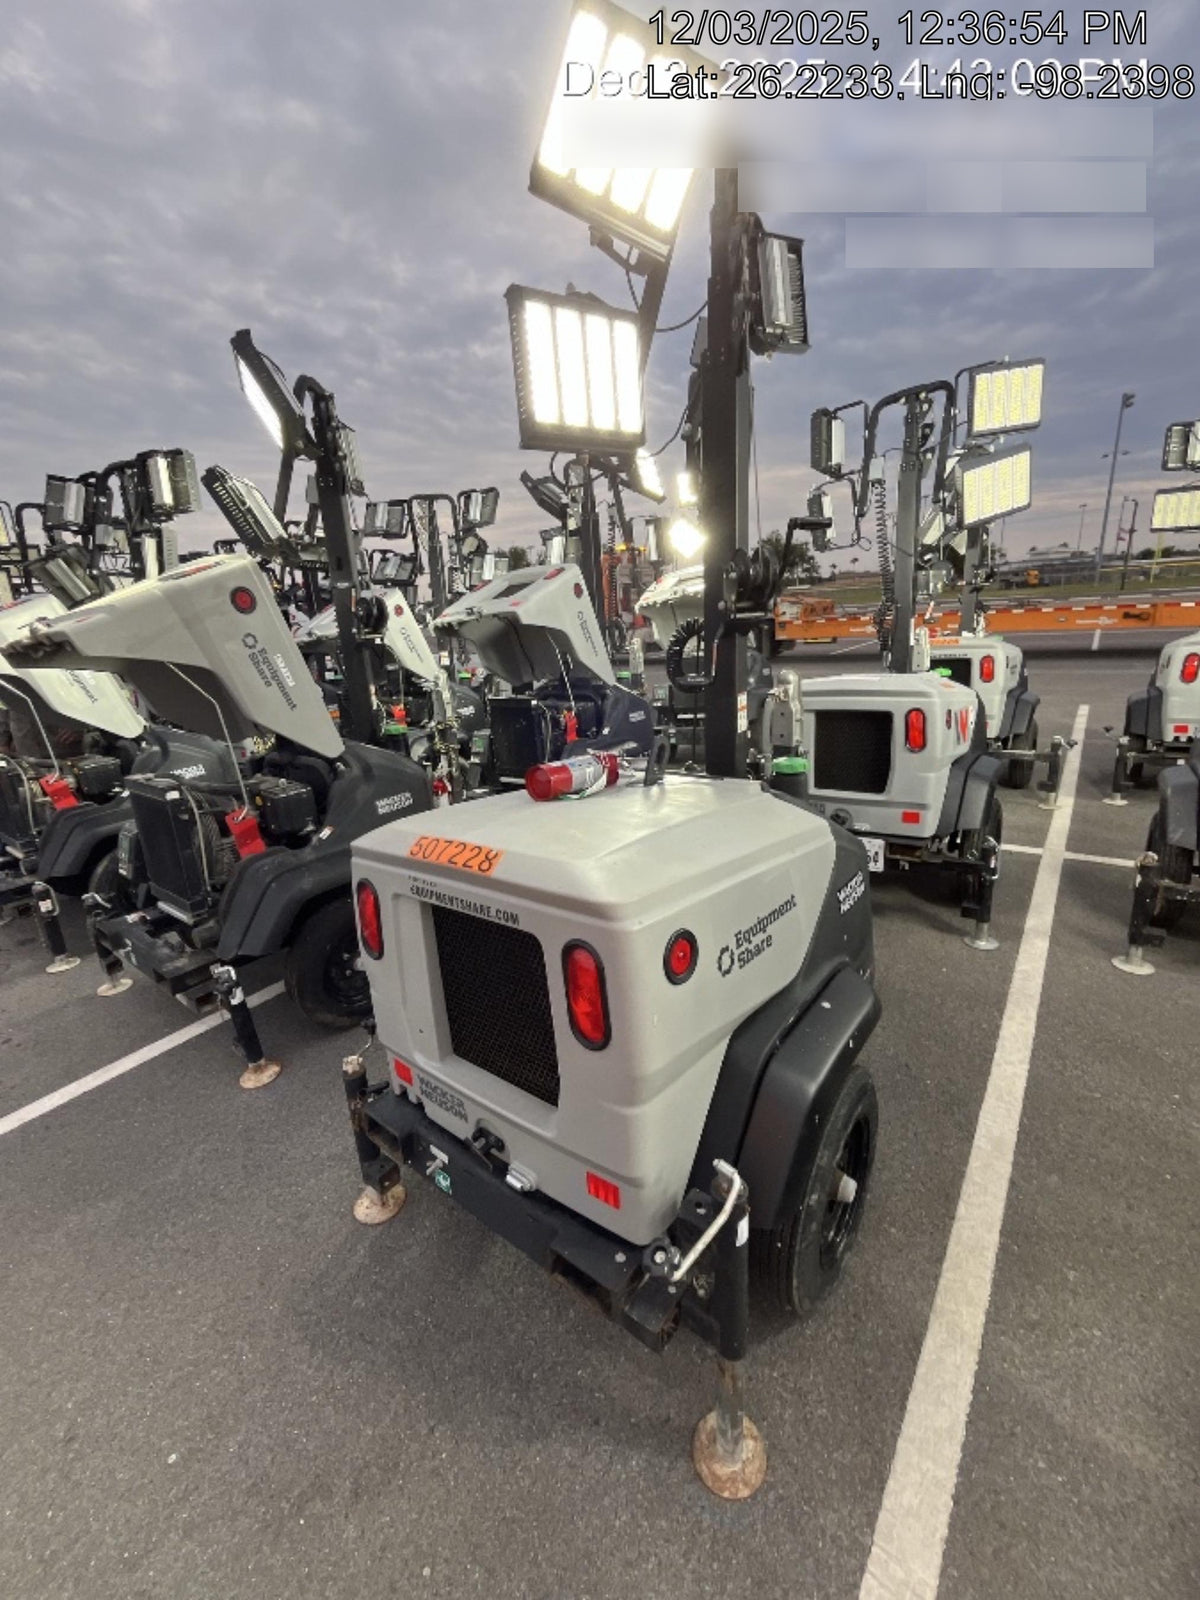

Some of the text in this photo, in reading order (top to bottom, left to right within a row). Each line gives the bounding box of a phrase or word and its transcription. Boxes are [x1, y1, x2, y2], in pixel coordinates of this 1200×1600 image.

[409, 836, 499, 874] 507228
[409, 884, 521, 927] EQUIPMENTSHARE.COM
[734, 893, 798, 951] Equipment
[736, 934, 773, 970] Share
